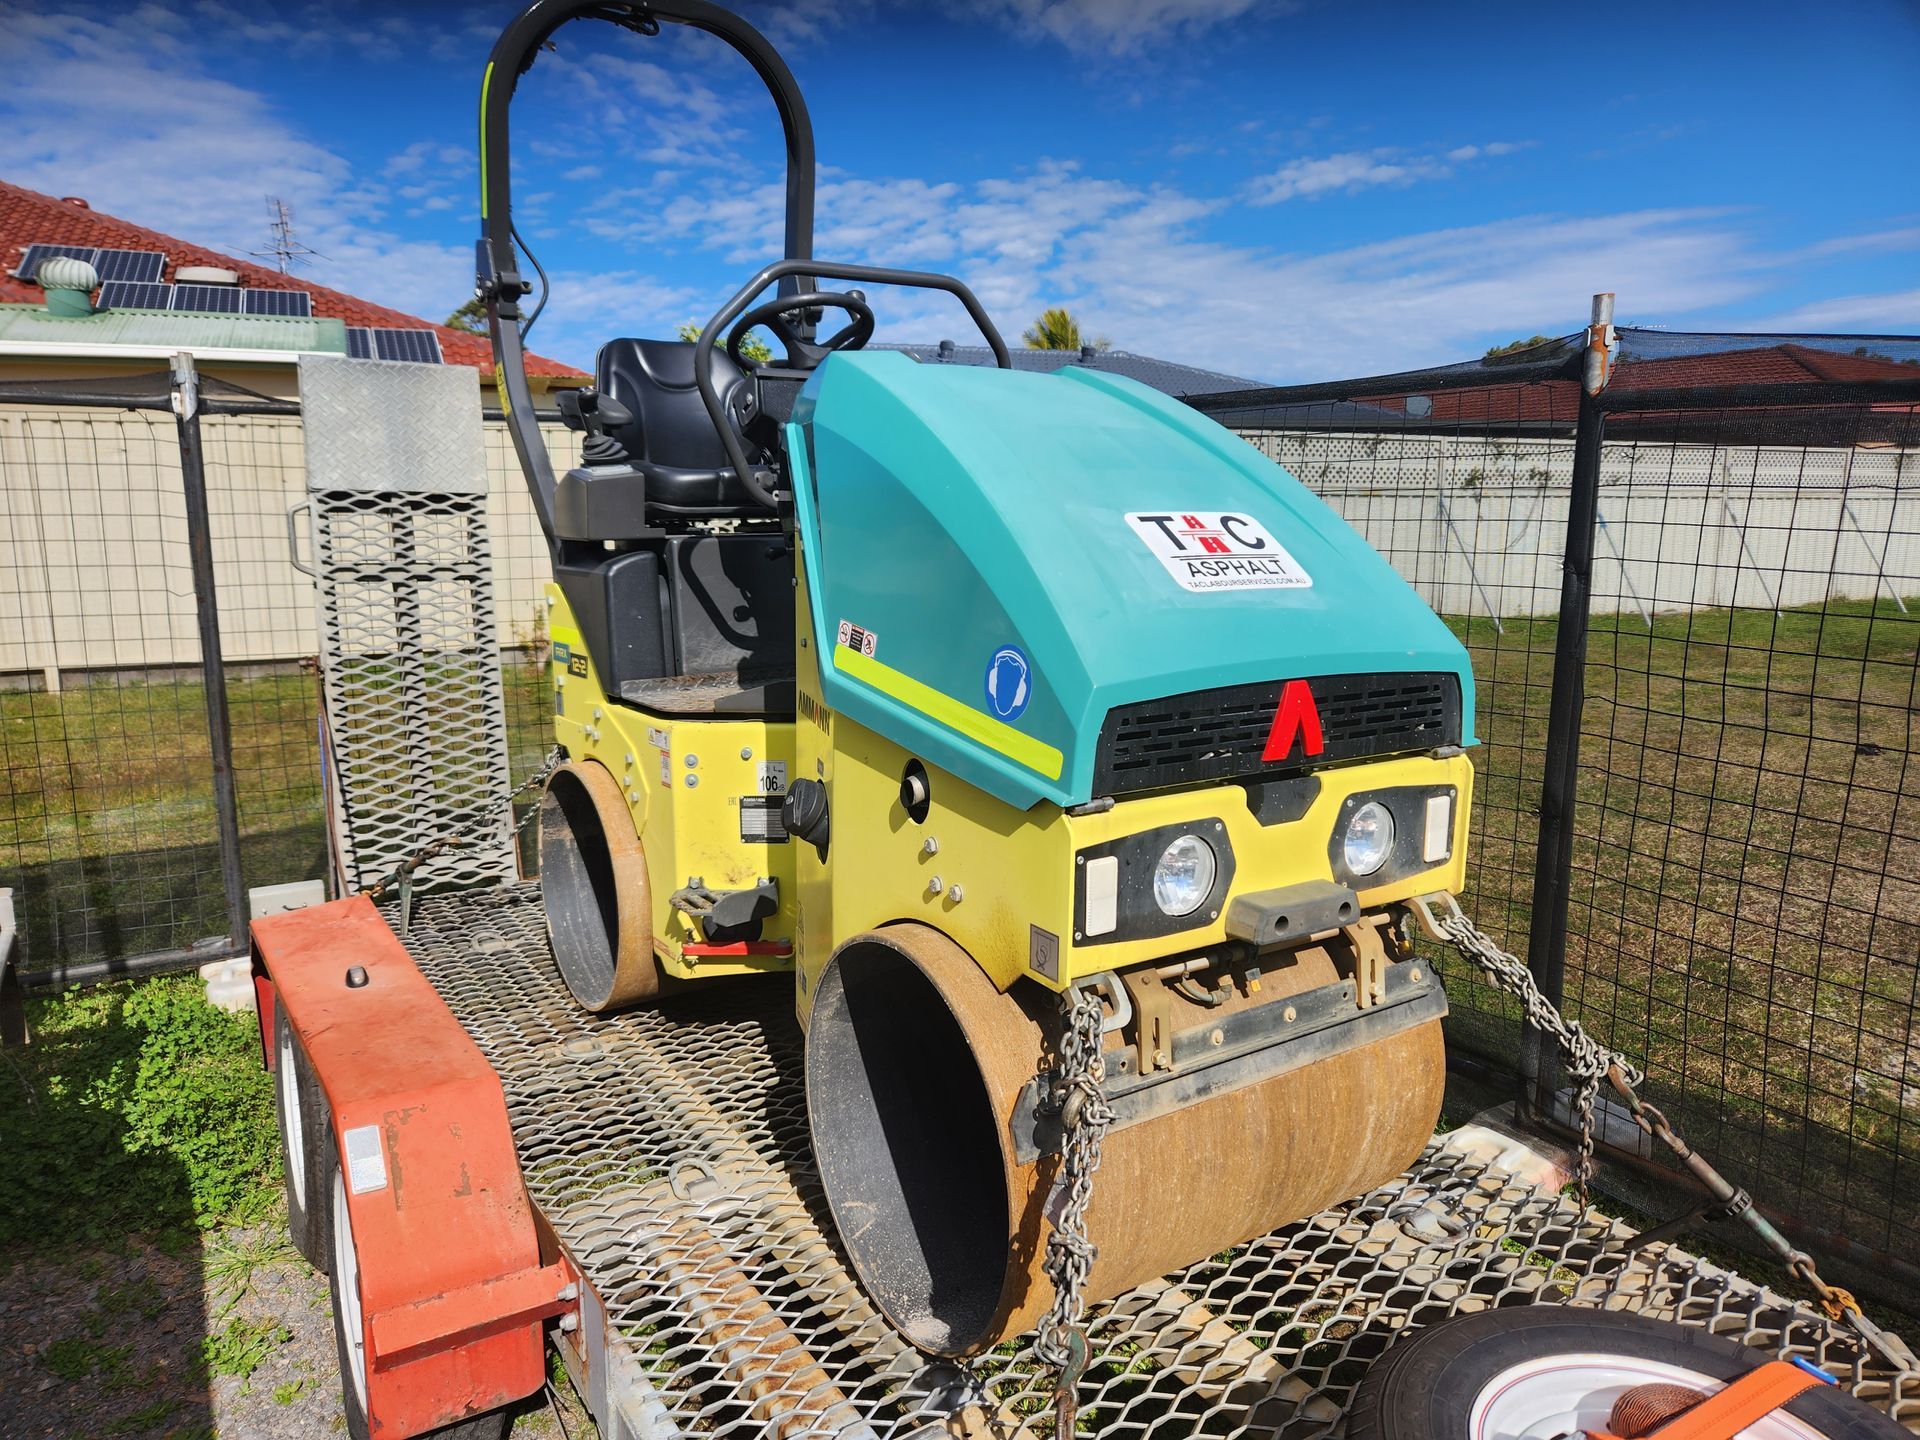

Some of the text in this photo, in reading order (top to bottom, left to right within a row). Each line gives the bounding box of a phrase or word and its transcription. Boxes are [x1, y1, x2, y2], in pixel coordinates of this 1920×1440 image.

[1186, 559, 1287, 578] ASPHALT
[1187, 578, 1307, 589] TACLABOURSERVICES.COM.AU
[798, 689, 831, 737] AMMANN
[760, 775, 778, 792] 106
